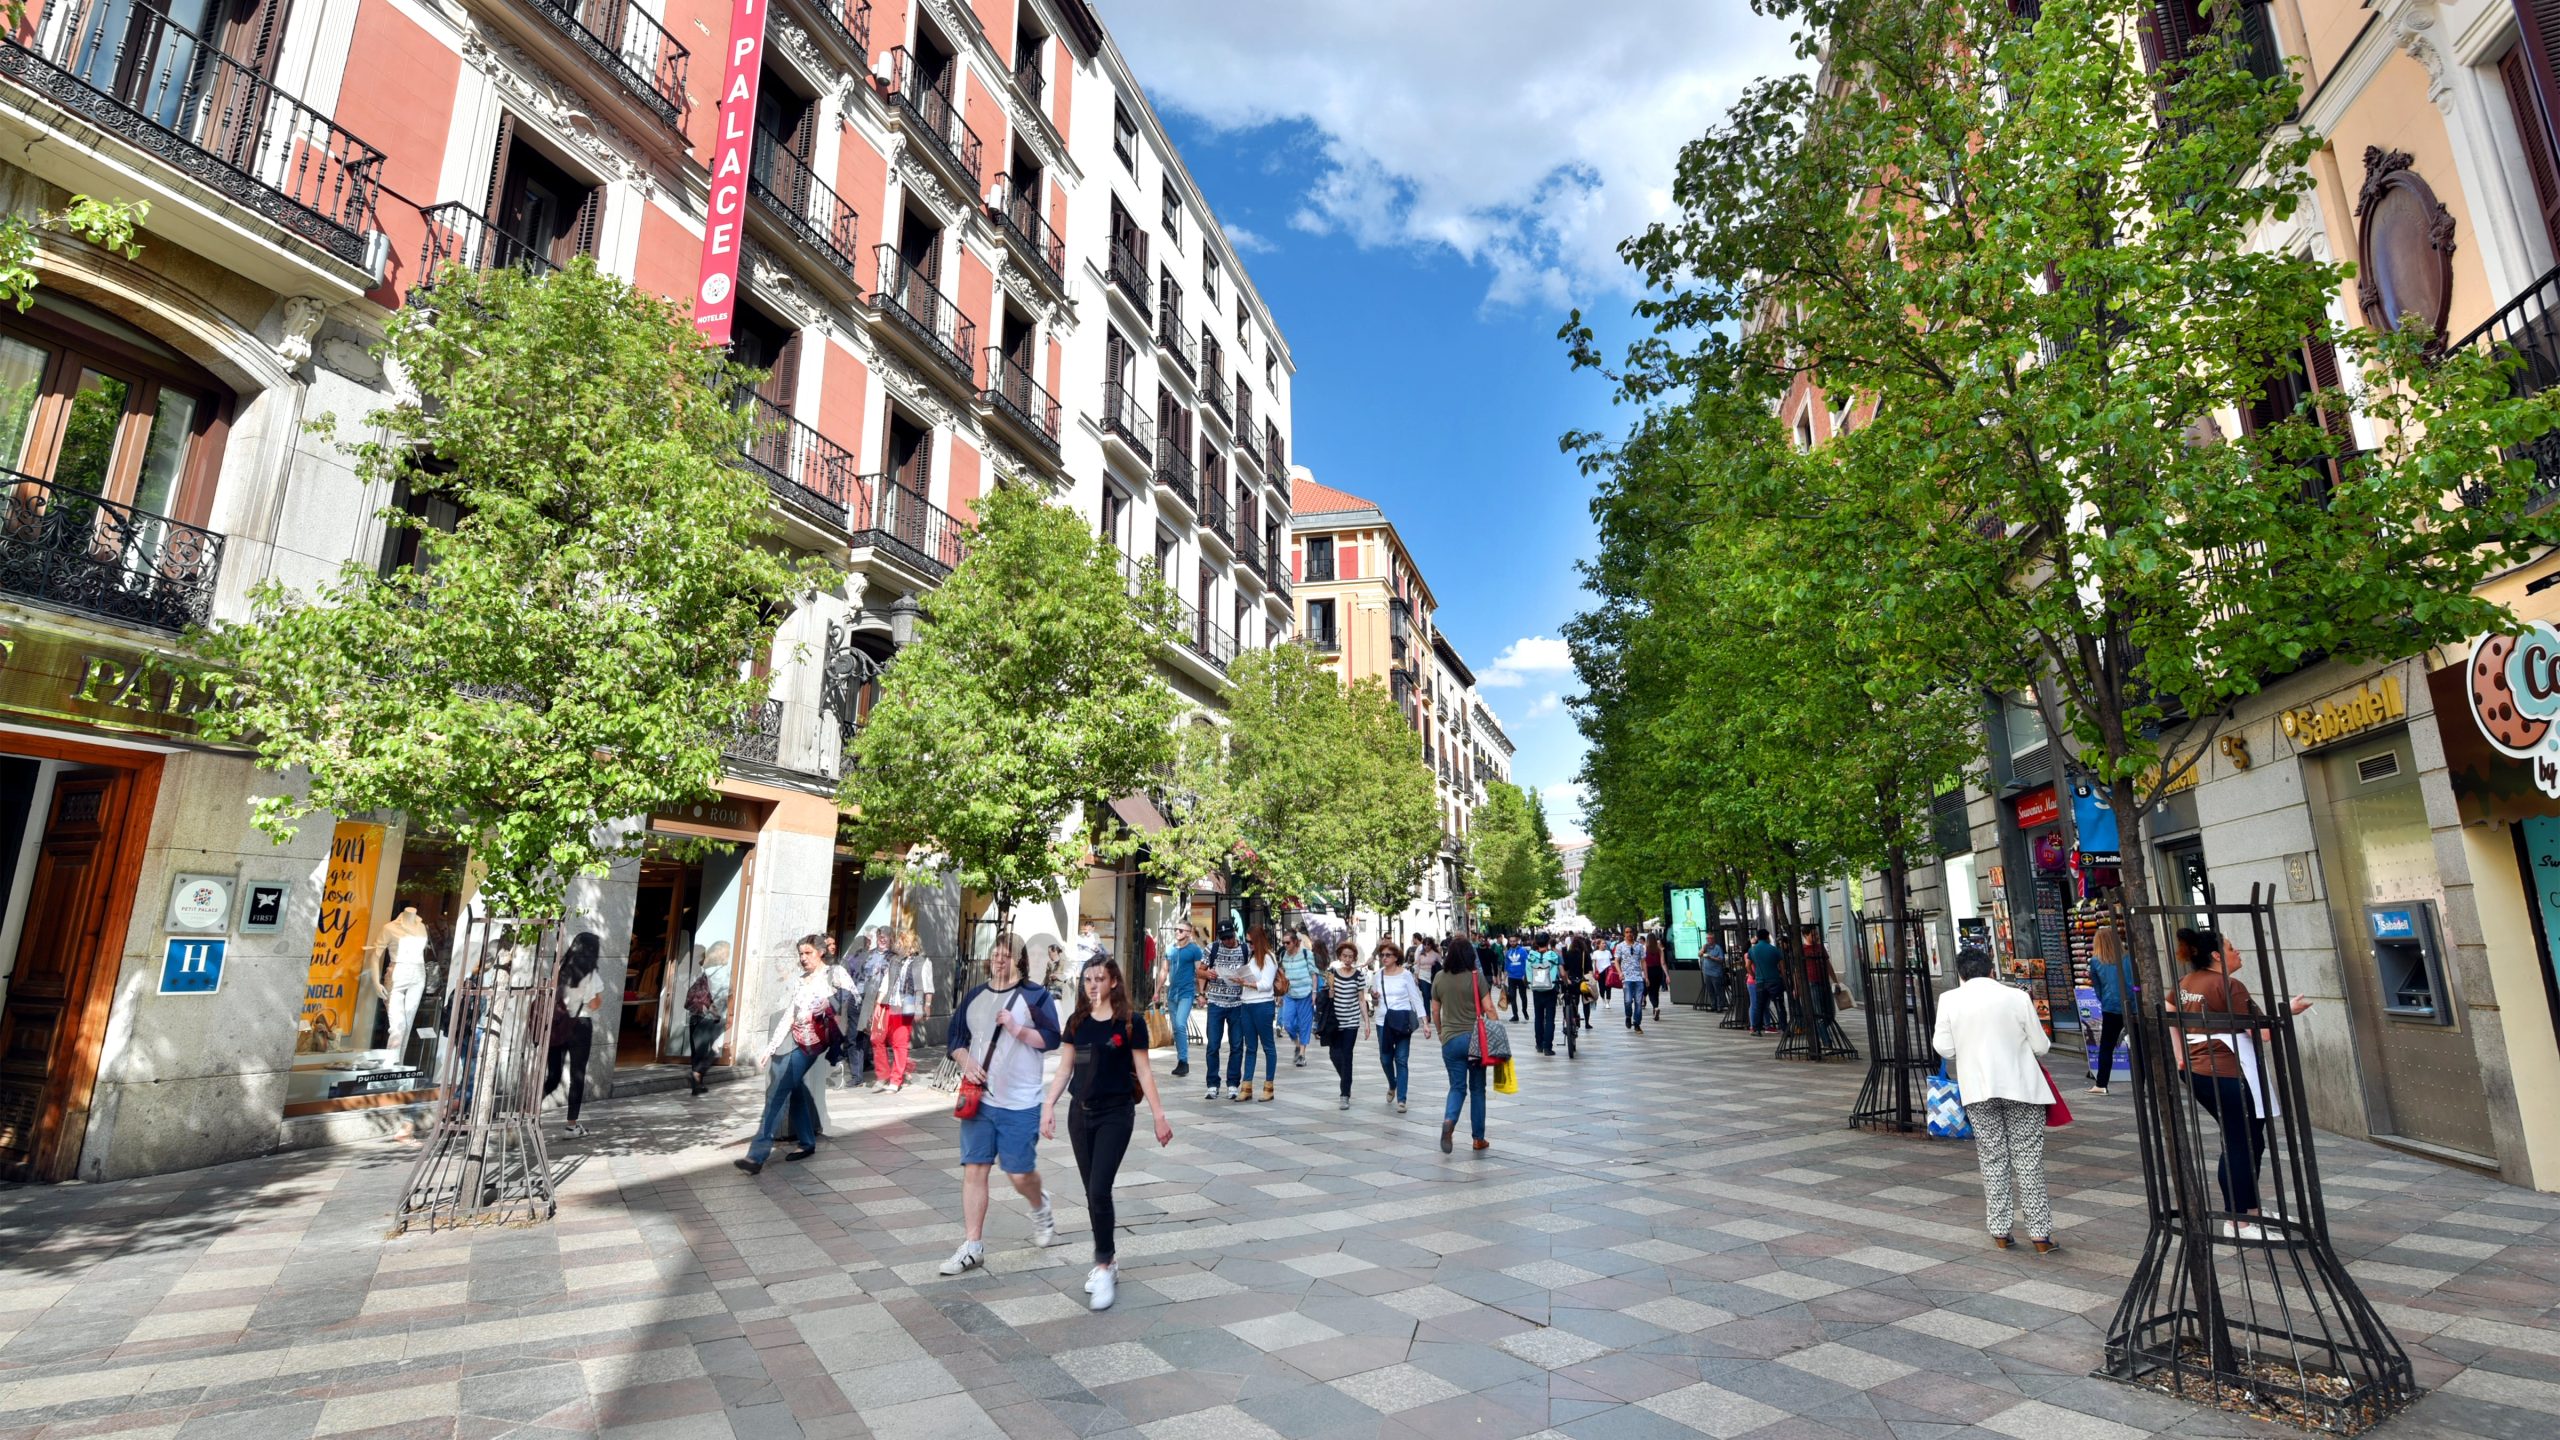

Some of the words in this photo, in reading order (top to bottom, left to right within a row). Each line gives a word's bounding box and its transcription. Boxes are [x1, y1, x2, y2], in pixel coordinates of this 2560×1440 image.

[712, 37, 755, 255] PALACE
[697, 312, 728, 324] HOTELES
[2299, 675, 2404, 747] Sabadell
[2229, 737, 2250, 770] S
[2539, 755, 2558, 790] by
[2044, 797, 2057, 812] Ma
[710, 807, 748, 825] ROMA
[328, 868, 357, 886] gre
[252, 914, 275, 922] FIRST
[2380, 919, 2409, 931] Sabadell
[179, 944, 211, 972] H
[304, 984, 343, 999] NDELA
[358, 1071, 424, 1083] puntroma.com
